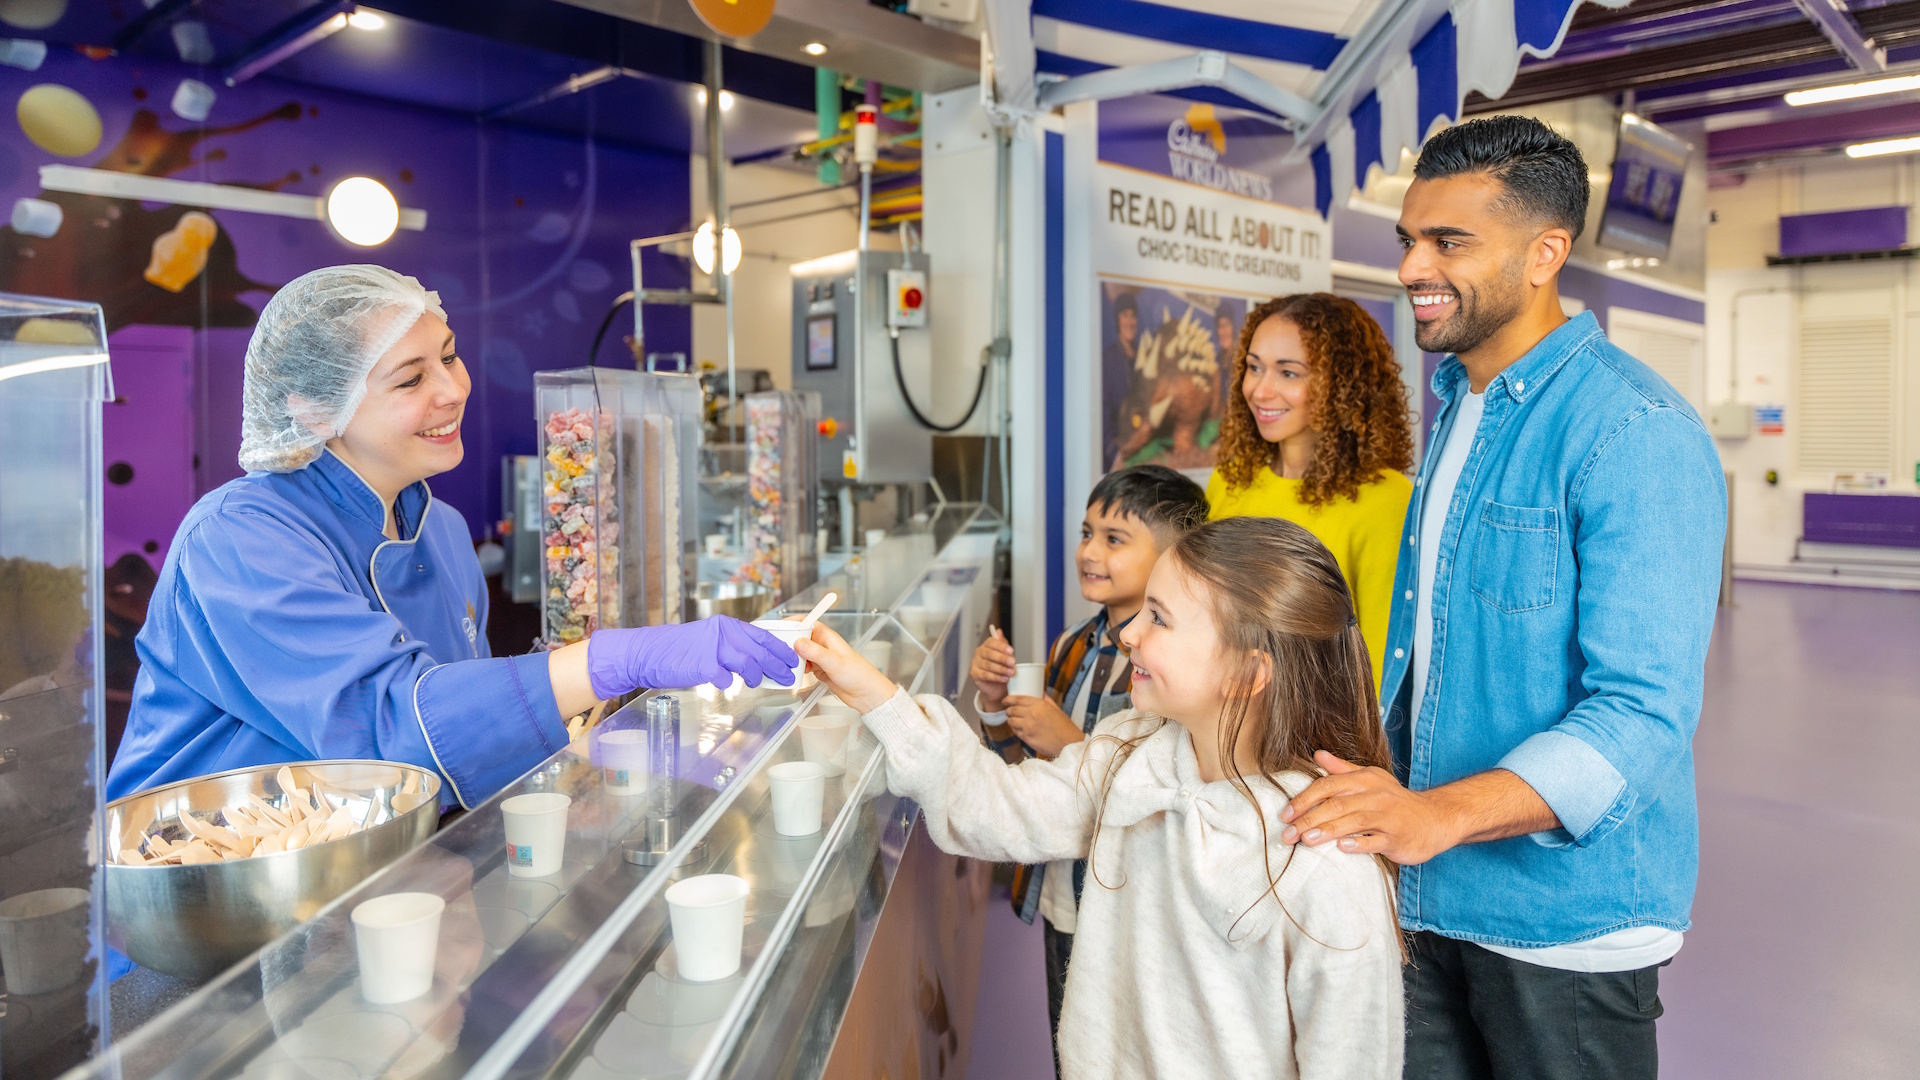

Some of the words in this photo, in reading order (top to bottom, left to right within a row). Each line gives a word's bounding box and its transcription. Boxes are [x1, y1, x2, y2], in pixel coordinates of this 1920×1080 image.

[1109, 188, 1176, 232] READ
[1184, 206, 1223, 242] ALL
[1229, 216, 1294, 254] ABOUT
[1300, 231, 1321, 261] IT!
[1137, 237, 1230, 273] CHOC-TASTIC
[1234, 253, 1301, 282] CREATIONS
